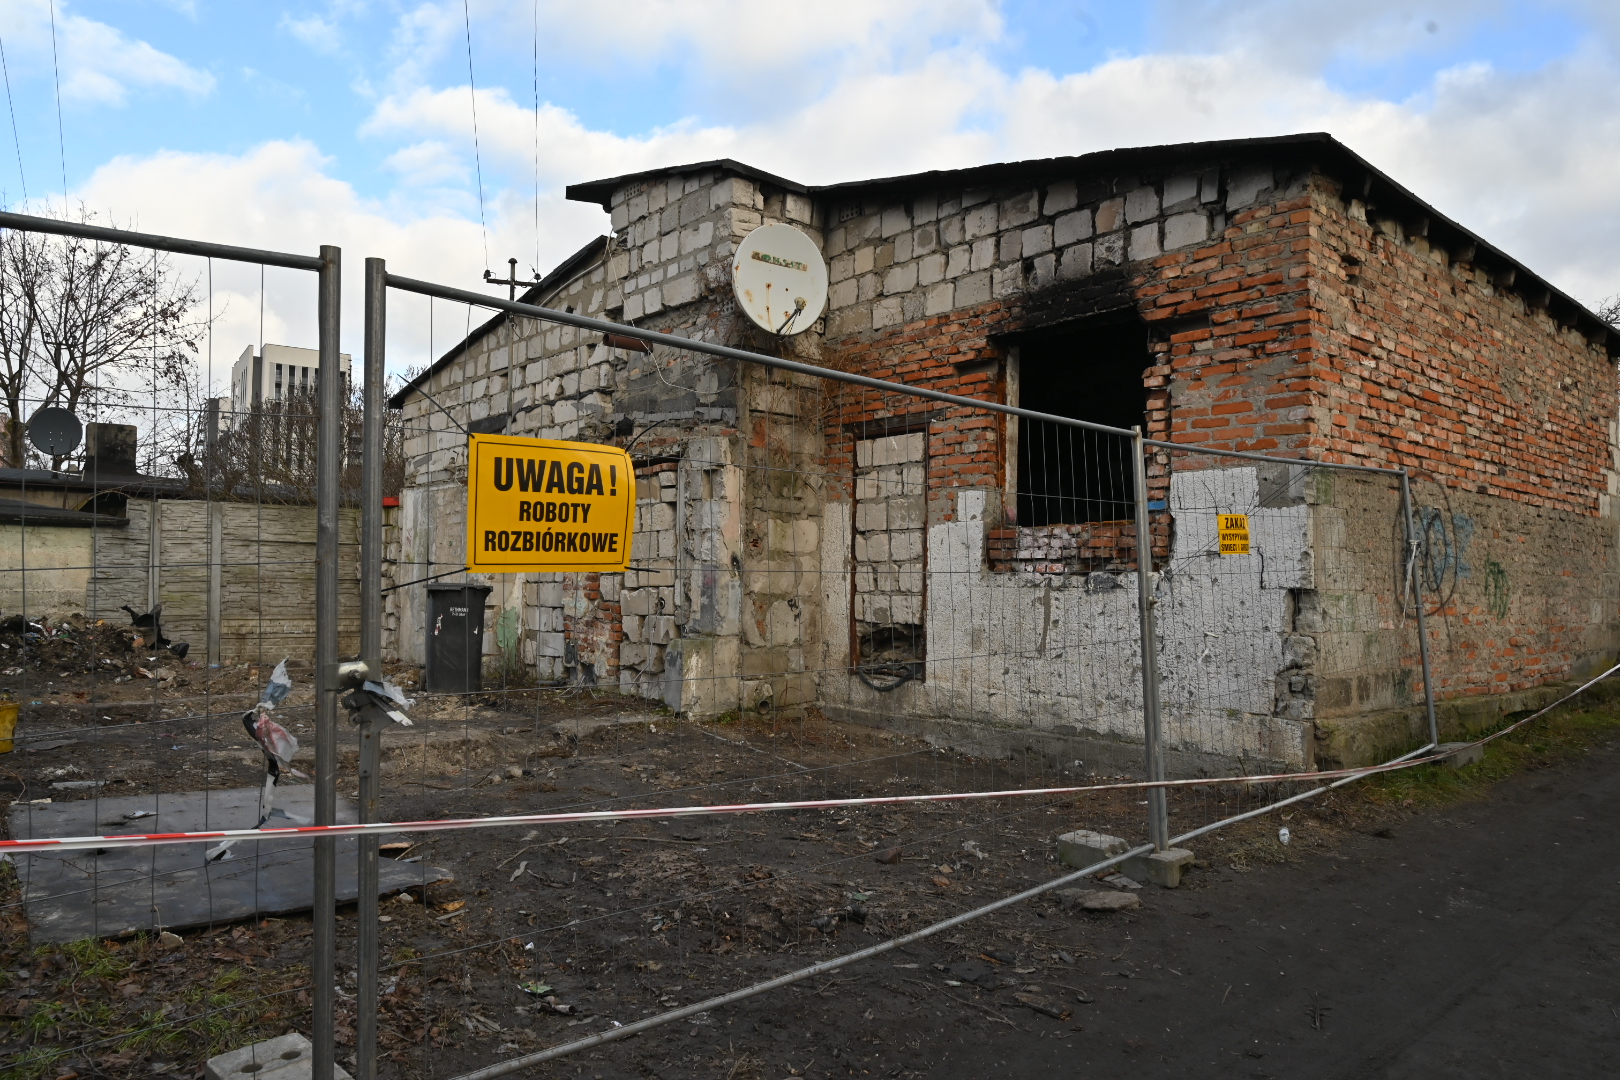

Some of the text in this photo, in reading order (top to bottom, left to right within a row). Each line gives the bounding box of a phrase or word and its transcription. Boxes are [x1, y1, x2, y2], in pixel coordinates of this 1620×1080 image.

[493, 456, 617, 496] UWAGA!
[518, 501, 592, 523] ROBOTY
[1225, 517, 1245, 529] ZAKAZ
[484, 527, 619, 553] ROZBIÓRKOWE
